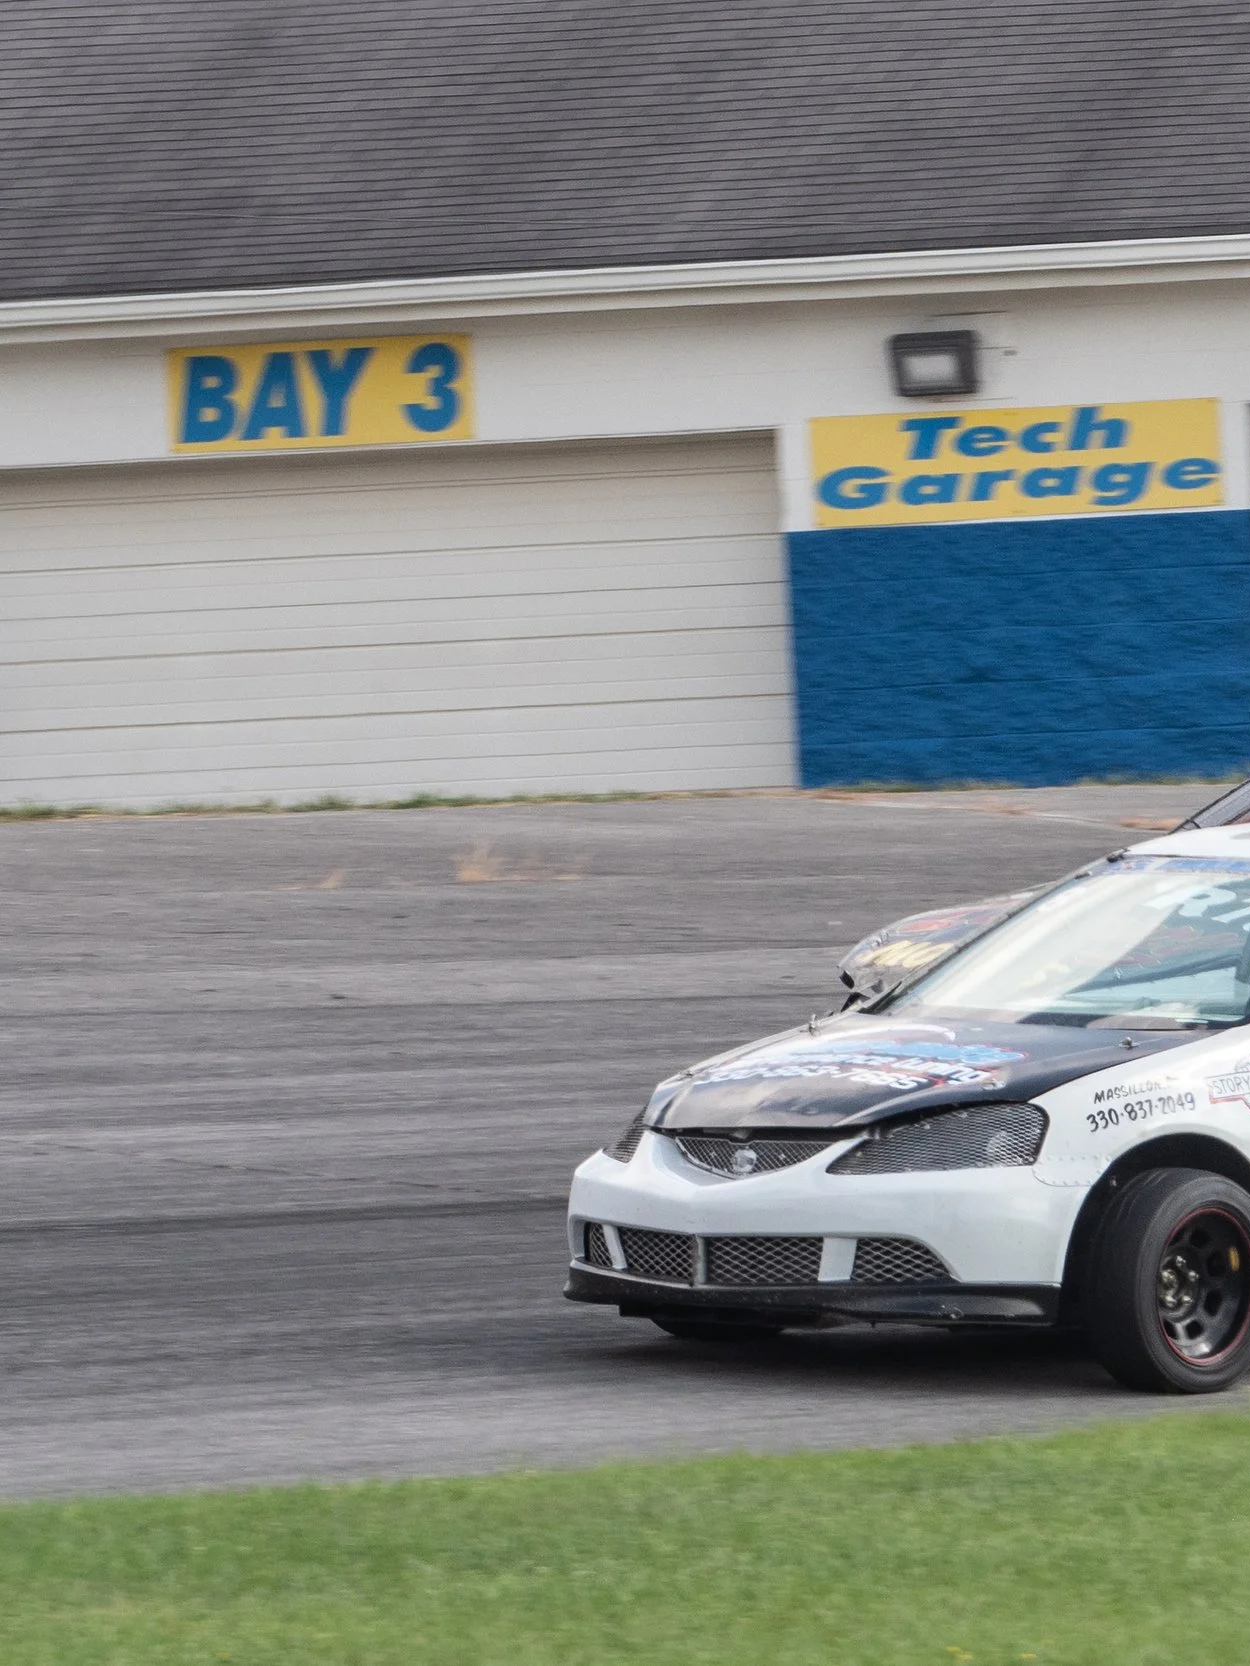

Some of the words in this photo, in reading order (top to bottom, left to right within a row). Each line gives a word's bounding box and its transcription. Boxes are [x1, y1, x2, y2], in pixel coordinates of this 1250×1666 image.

[179, 345, 375, 444] BAY
[400, 342, 463, 433] 3
[899, 406, 1132, 461] Tech
[816, 456, 1222, 510] Garage
